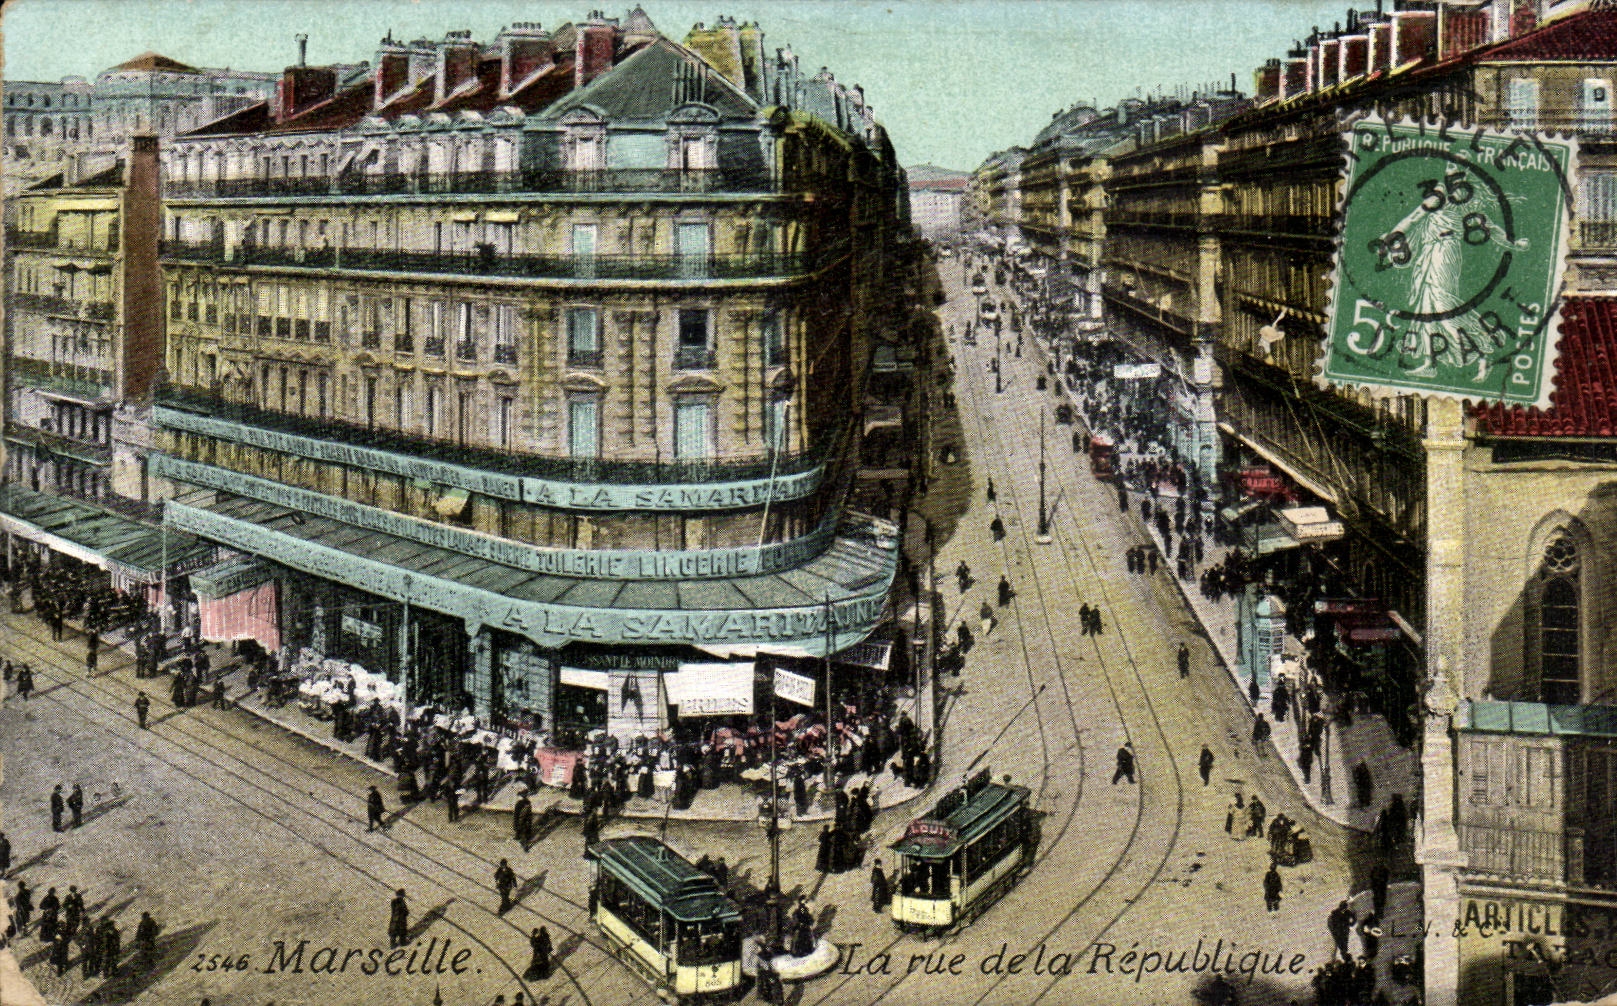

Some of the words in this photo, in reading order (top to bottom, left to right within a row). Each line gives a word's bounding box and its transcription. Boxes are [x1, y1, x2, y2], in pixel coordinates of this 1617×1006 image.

[1475, 144, 1558, 173] FRANÇAIS
[534, 484, 561, 505] A
[568, 486, 615, 508] LA
[638, 553, 750, 579] LINGERIE
[502, 606, 529, 631] A
[543, 608, 603, 639] LA
